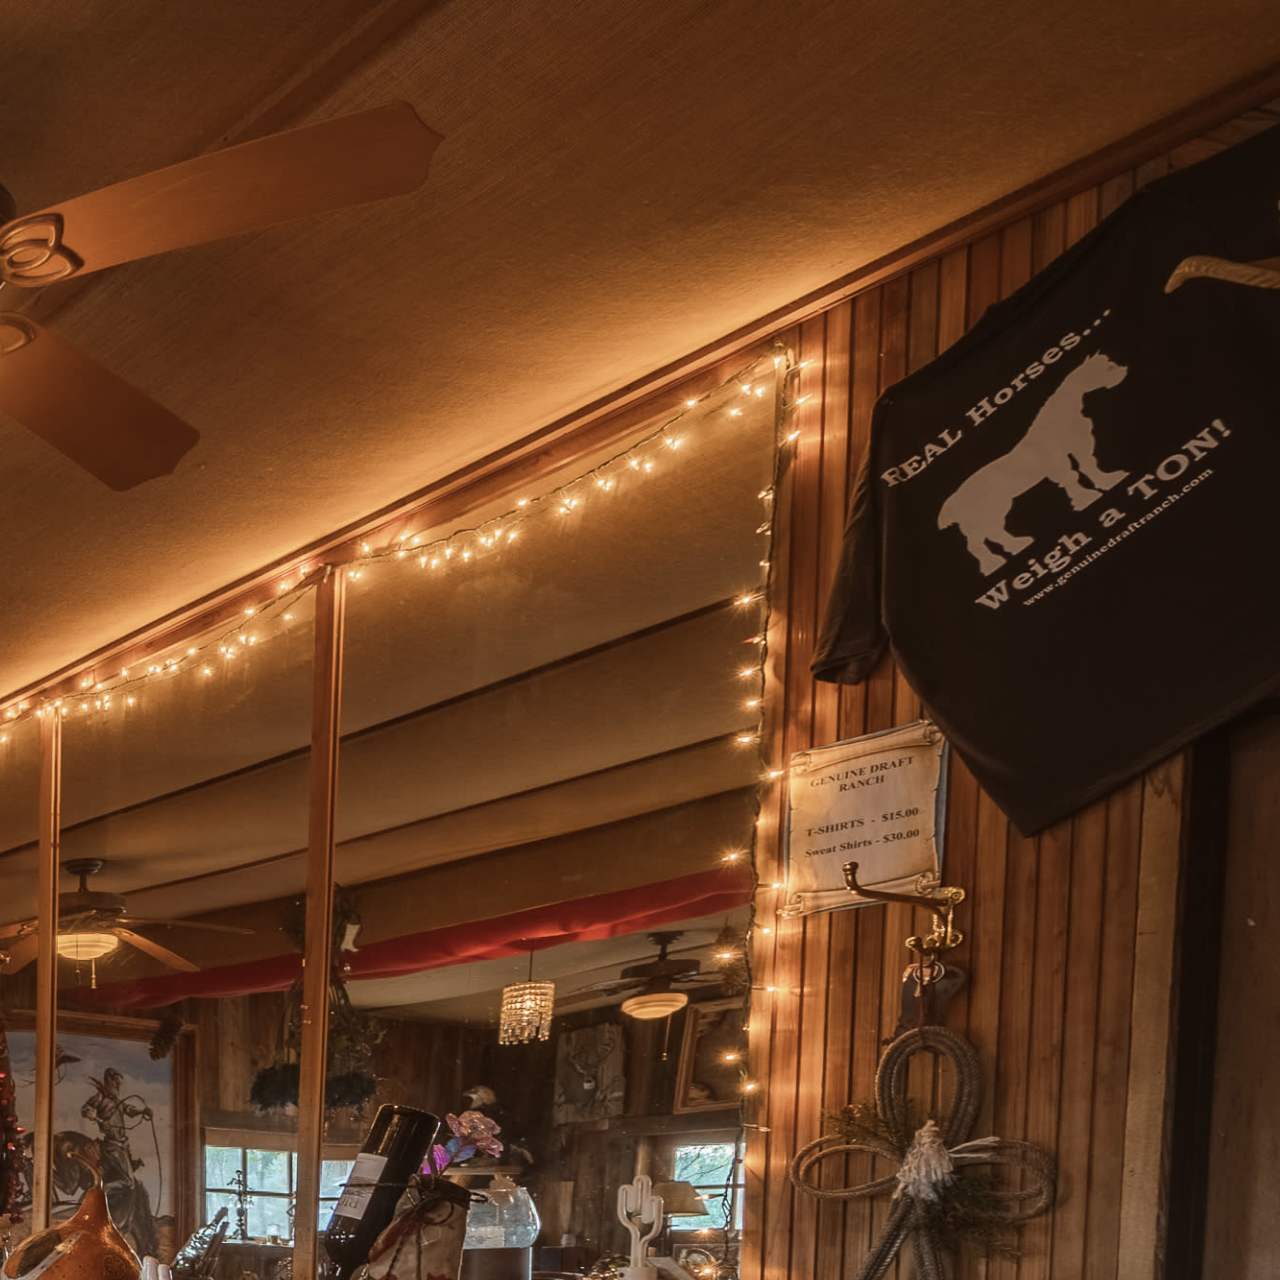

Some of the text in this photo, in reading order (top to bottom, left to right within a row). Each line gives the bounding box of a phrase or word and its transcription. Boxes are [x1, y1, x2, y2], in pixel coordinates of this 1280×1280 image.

[880, 429, 963, 487] REAL
[974, 418, 1232, 610] Weigh a TON!
[1023, 468, 1214, 606] www.genuinedraftranch.com
[810, 756, 913, 788] GENUINE DRAFT
[839, 775, 885, 793] RANCH
[807, 818, 865, 837] T-SHIRTS
[881, 807, 919, 822] $15.00
[804, 846, 837, 858] Sweat
[839, 838, 873, 852] Shirts
[882, 829, 920, 844] $30.00
